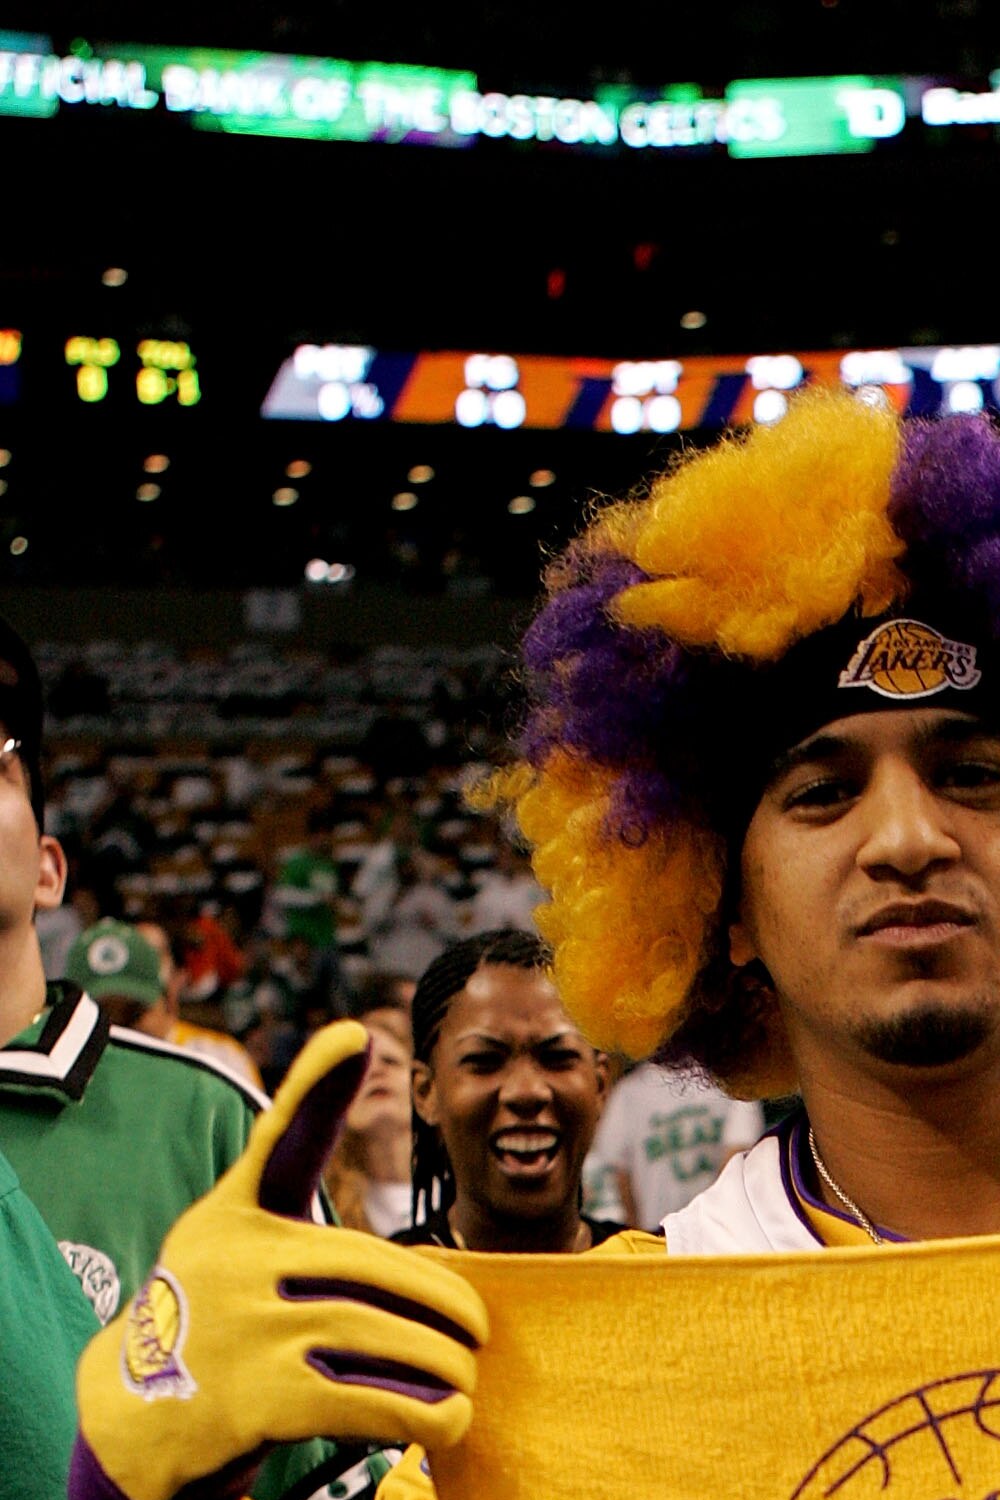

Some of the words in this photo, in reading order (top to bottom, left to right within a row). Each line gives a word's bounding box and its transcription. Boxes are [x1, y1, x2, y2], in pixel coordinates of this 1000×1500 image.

[0, 51, 159, 109] FFICIAL
[162, 64, 285, 116] BANK
[291, 76, 351, 122] OF
[360, 83, 448, 133] THE
[450, 91, 617, 145] BOSTON
[619, 97, 787, 148] CELTICS
[846, 641, 977, 686] LAKERS
